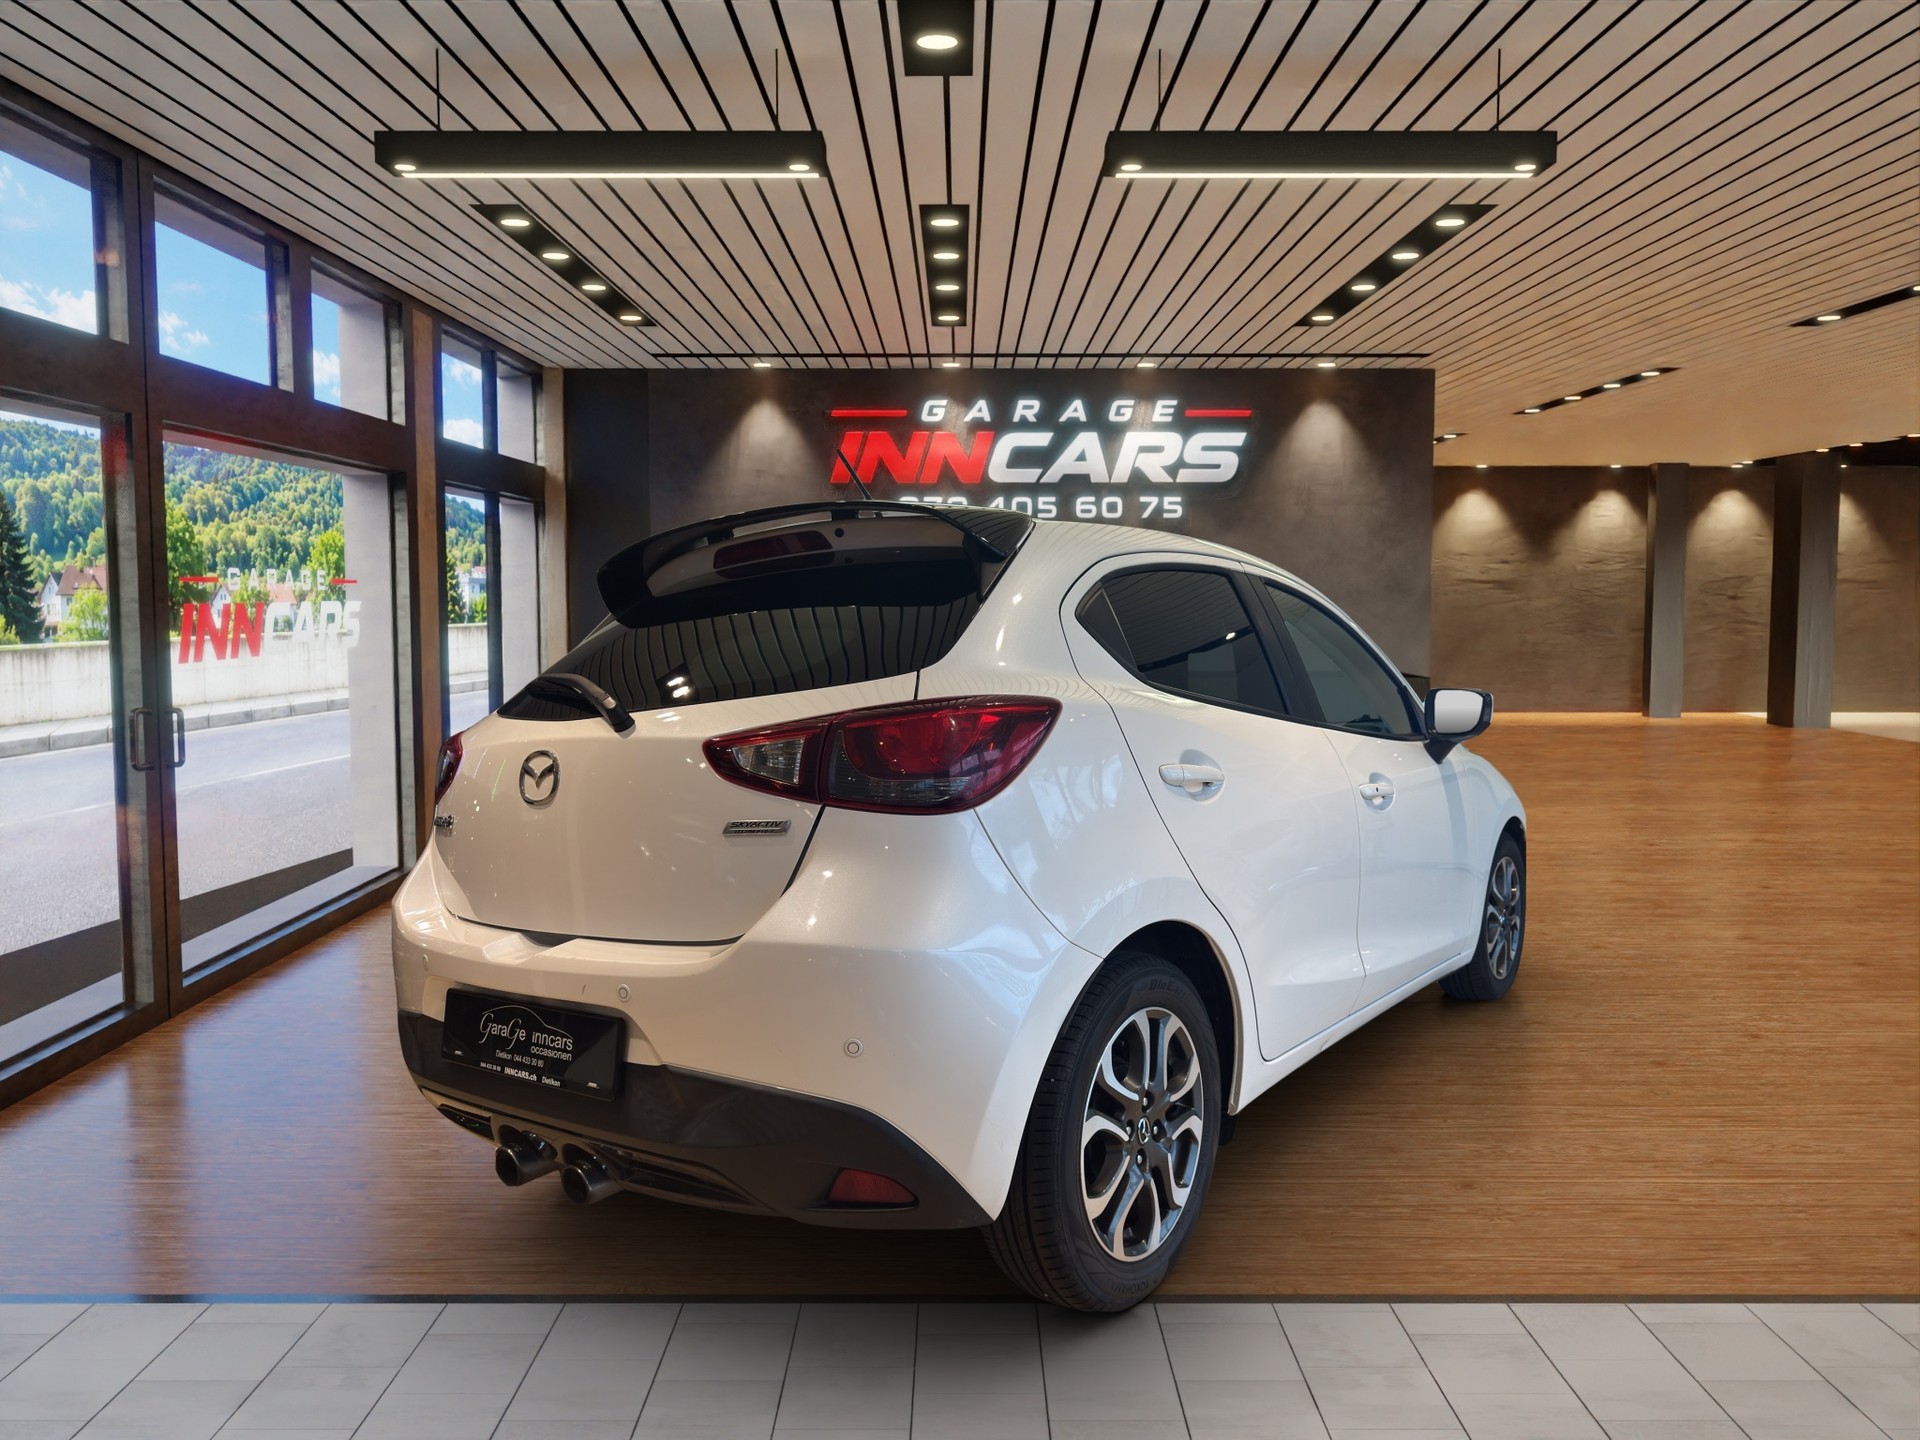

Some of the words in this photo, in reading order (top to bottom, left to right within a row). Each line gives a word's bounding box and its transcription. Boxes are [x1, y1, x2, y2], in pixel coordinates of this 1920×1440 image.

[920, 398, 1179, 422] GARAGE
[829, 430, 1247, 485] INNCARS
[1075, 495, 1124, 519] 60
[1140, 495, 1183, 519] 75
[227, 567, 328, 591] GARAGE
[178, 600, 362, 664] INNCARS
[479, 1012, 526, 1050] GaraGe
[532, 1031, 573, 1050] inncars
[495, 1049, 512, 1060] Dietikon
[530, 1045, 572, 1061] occasionen
[504, 1066, 537, 1081] INNCARS.ch
[541, 1075, 561, 1087] Dietikon
